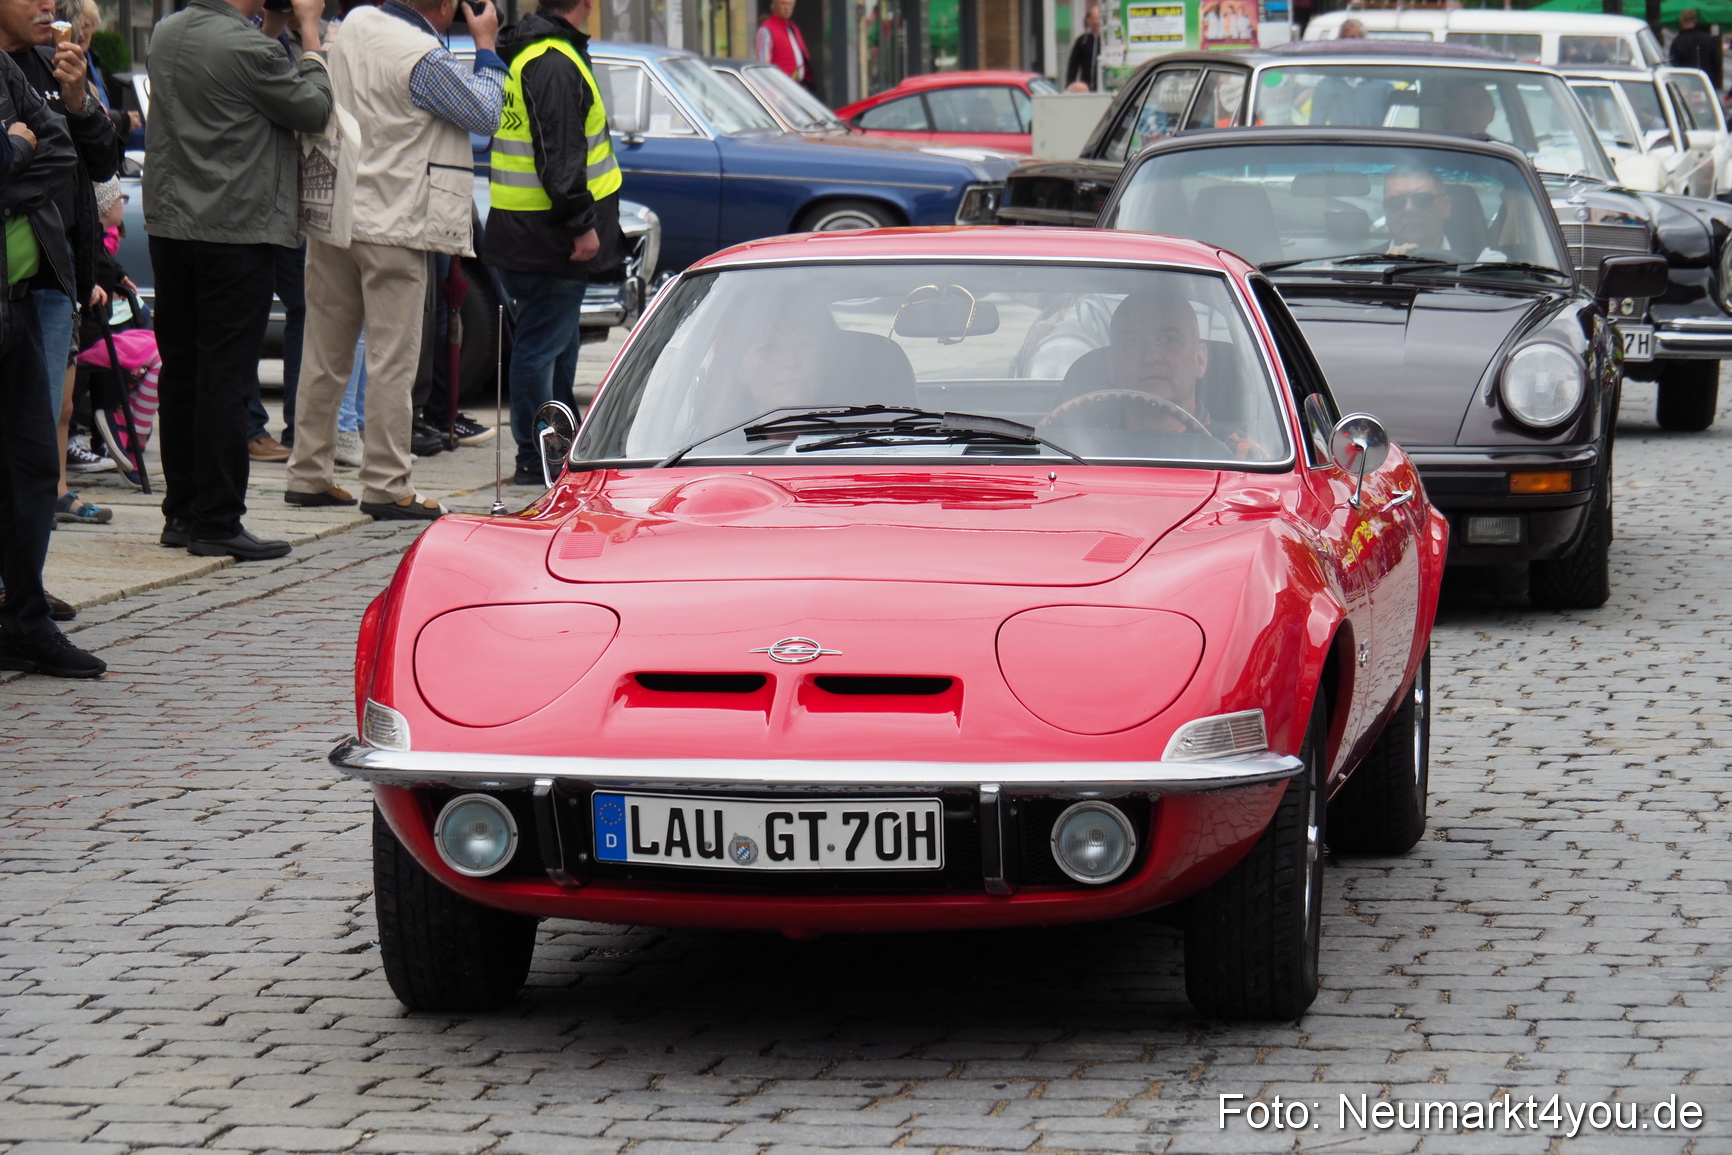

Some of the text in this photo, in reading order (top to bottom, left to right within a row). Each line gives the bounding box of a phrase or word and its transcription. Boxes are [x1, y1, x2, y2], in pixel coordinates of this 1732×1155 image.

[1625, 333, 1649, 354] 7H
[605, 833, 618, 849] D
[630, 804, 724, 860] LAU
[765, 811, 827, 862] GT
[841, 810, 937, 861] 70H
